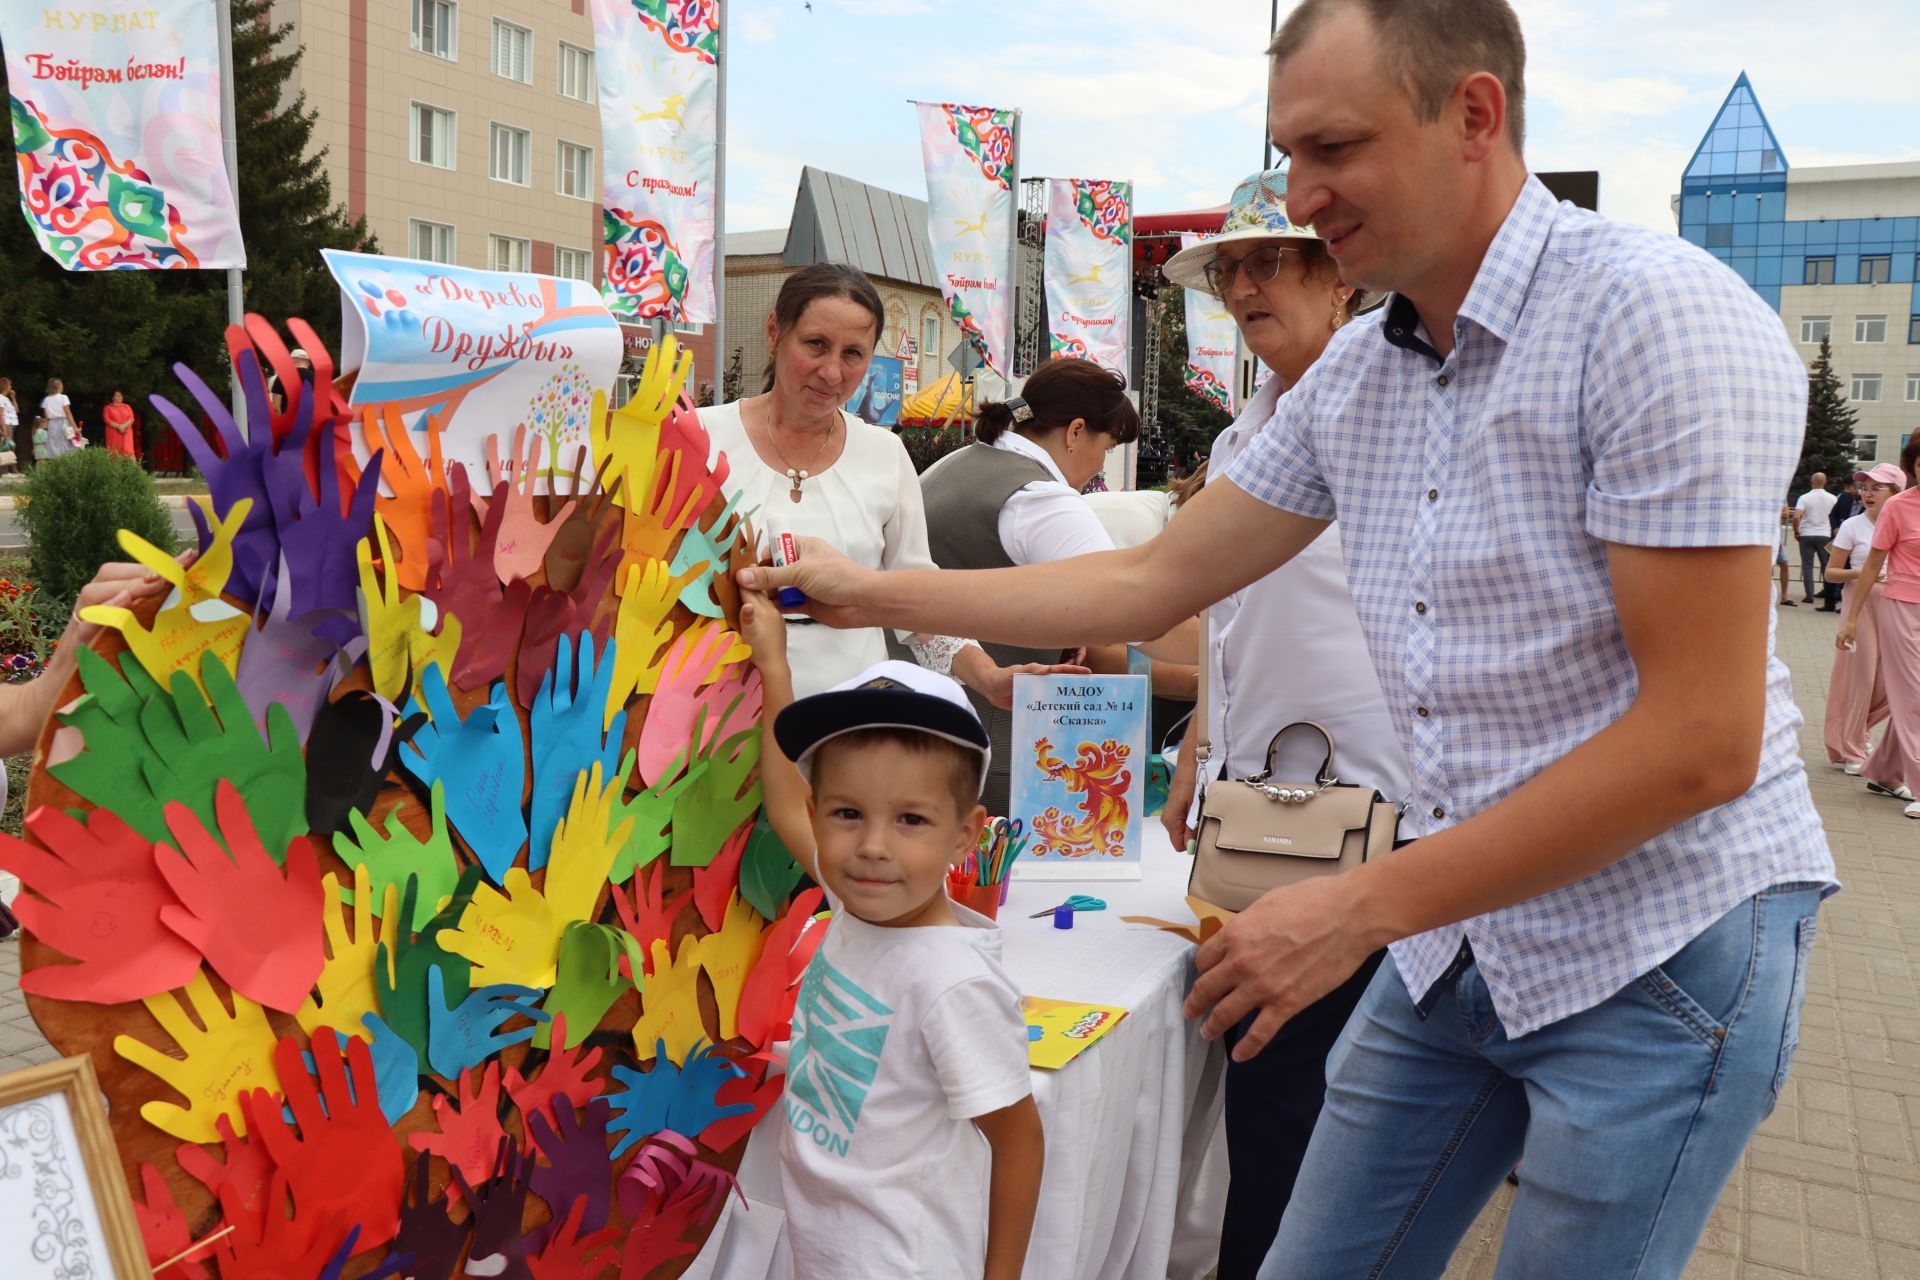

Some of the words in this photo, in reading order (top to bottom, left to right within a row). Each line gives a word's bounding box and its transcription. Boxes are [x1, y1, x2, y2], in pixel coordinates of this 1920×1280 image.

[43, 9, 160, 33] НУРЛАТ
[25, 53, 123, 91] Бәйрәм
[127, 54, 185, 82] белән!
[626, 170, 639, 188] С
[415, 273, 544, 310] «Дерево
[1062, 311, 1070, 322] С
[422, 315, 574, 371] Дружбы»
[1056, 686, 1105, 697] МАДОУ
[1026, 701, 1081, 712] «Детский
[1083, 703, 1102, 712] сад
[1105, 701, 1118, 711] №
[1122, 702, 1134, 711] 14
[1053, 715, 1107, 726] «Сказка»
[785, 1098, 850, 1158] NDON
